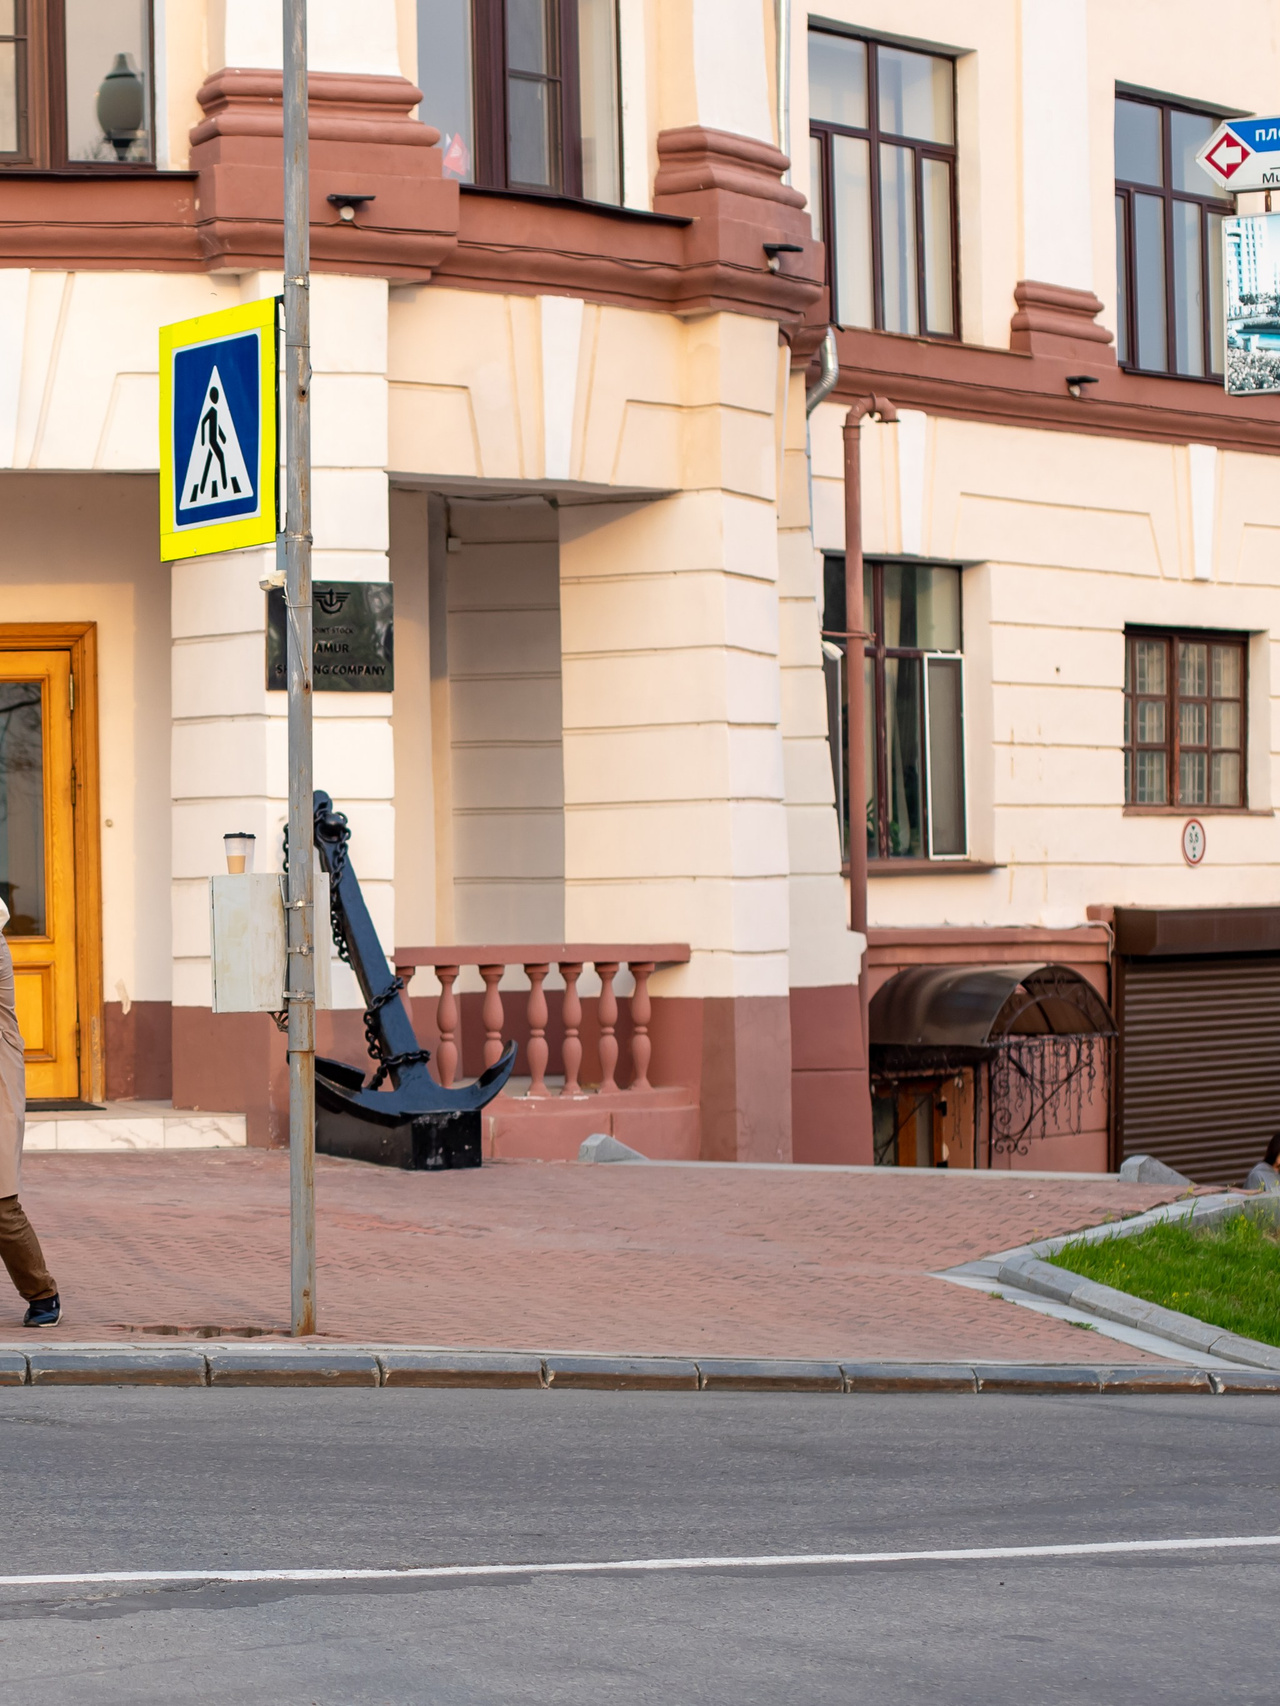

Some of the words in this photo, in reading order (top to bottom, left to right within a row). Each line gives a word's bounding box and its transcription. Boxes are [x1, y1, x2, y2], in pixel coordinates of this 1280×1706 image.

[313, 626, 330, 634] OINT
[332, 625, 354, 634] STOCK
[316, 643, 349, 654] AMUR
[332, 665, 386, 675] COMPANY
